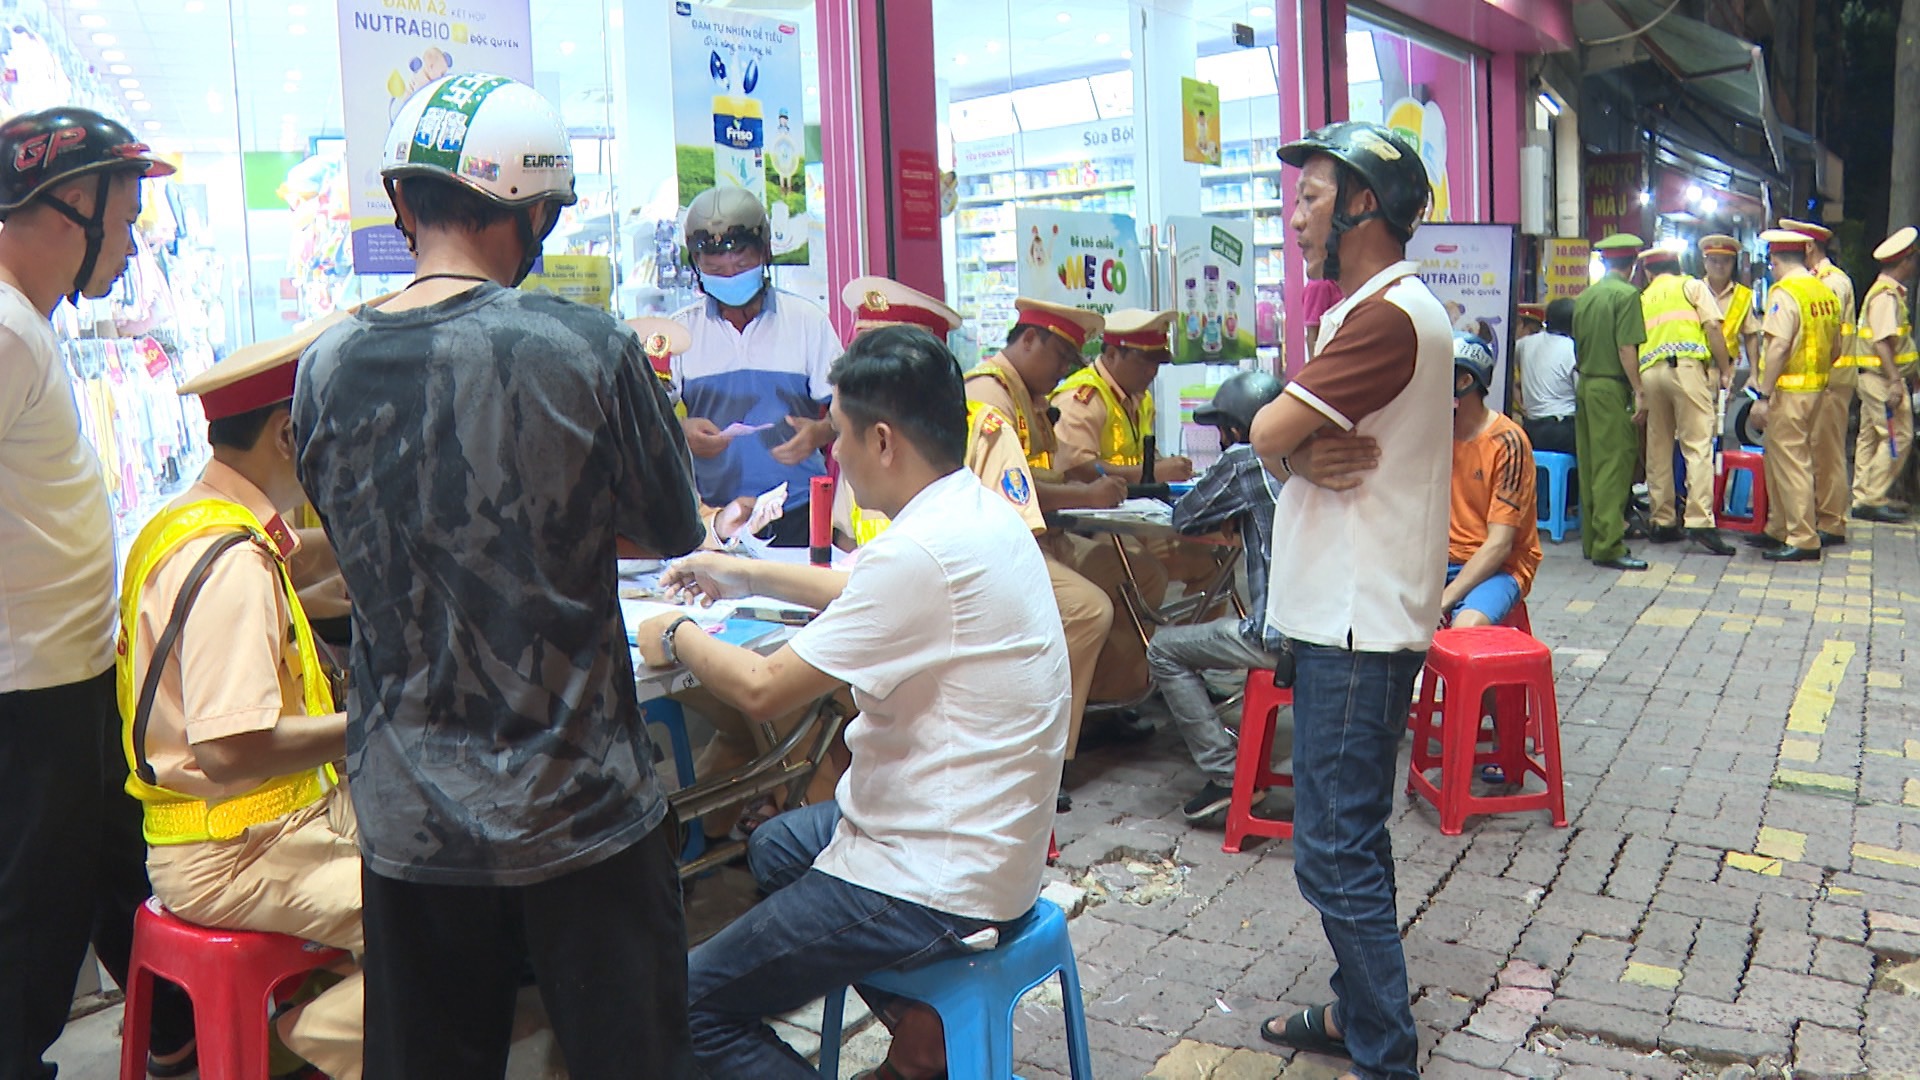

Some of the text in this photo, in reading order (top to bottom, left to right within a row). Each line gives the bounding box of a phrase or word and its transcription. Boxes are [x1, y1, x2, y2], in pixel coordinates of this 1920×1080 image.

[355, 11, 449, 40] NUTRABIO
[726, 126, 753, 141] Friso
[523, 154, 554, 168] EURO
[1065, 247, 1127, 300] MẸ CÓ
[1417, 273, 1480, 286] UTRABIO
[1075, 303, 1114, 316] EWY
